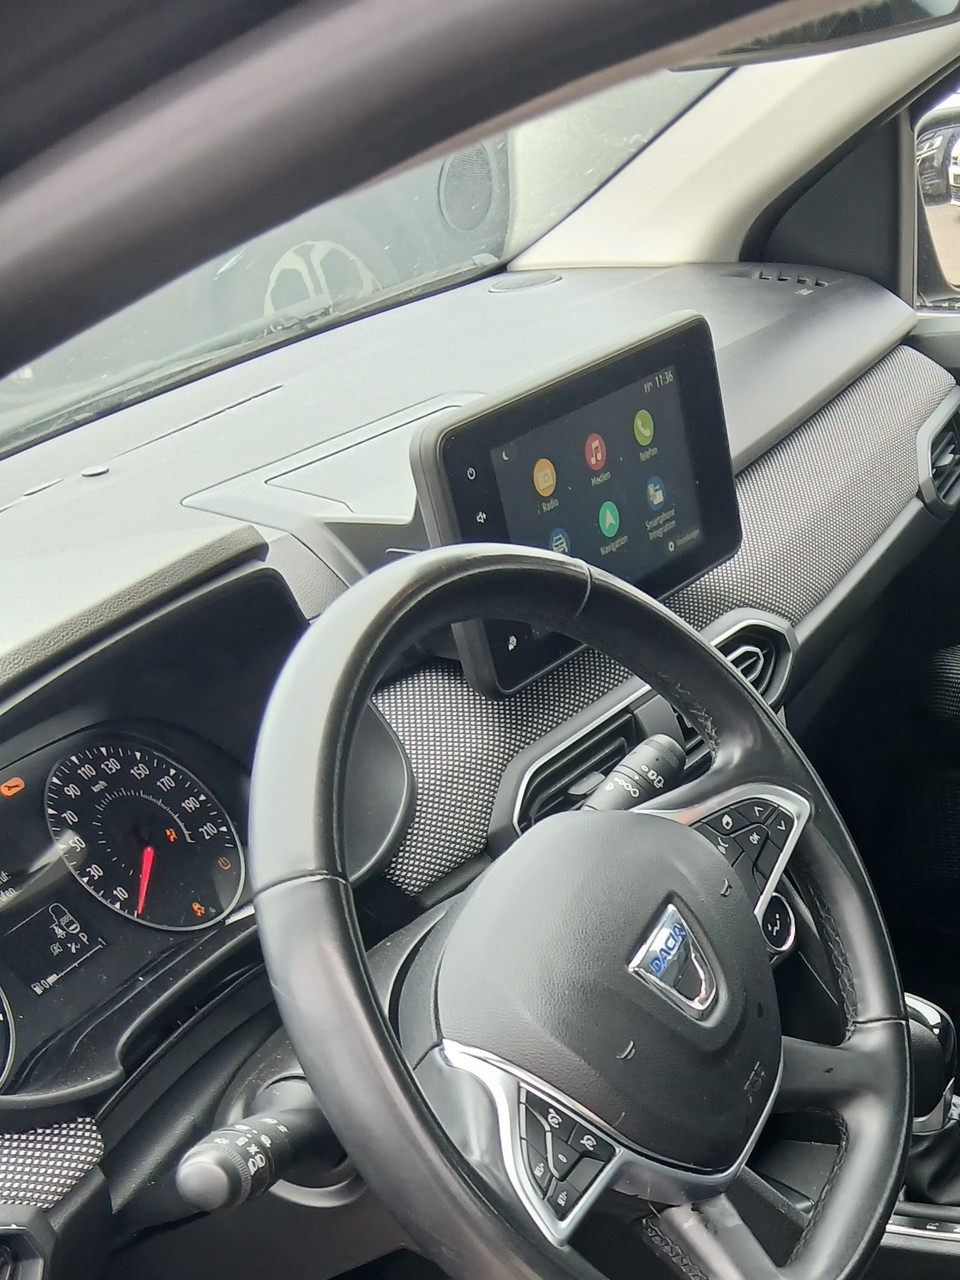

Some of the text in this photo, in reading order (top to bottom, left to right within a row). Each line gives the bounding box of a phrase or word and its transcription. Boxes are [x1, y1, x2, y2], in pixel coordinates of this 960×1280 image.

[655, 370, 674, 388] 11:36
[590, 471, 611, 487] Medien
[542, 498, 560, 512] Radio
[77, 764, 97, 780] 110
[101, 757, 121, 775] 130
[130, 763, 150, 780] 150
[63, 783, 81, 799] 90
[90, 780, 109, 793] km/h
[156, 775, 176, 792] 170
[181, 796, 200, 813] 190
[61, 810, 79, 825] 70
[198, 822, 218, 840] 210
[749, 832, 761, 844] OK
[68, 836, 86, 852] 50
[86, 864, 104, 880] 30
[112, 886, 129, 901] 10
[650, 923, 687, 977] DACIA
[925, 1222, 940, 1230] R
